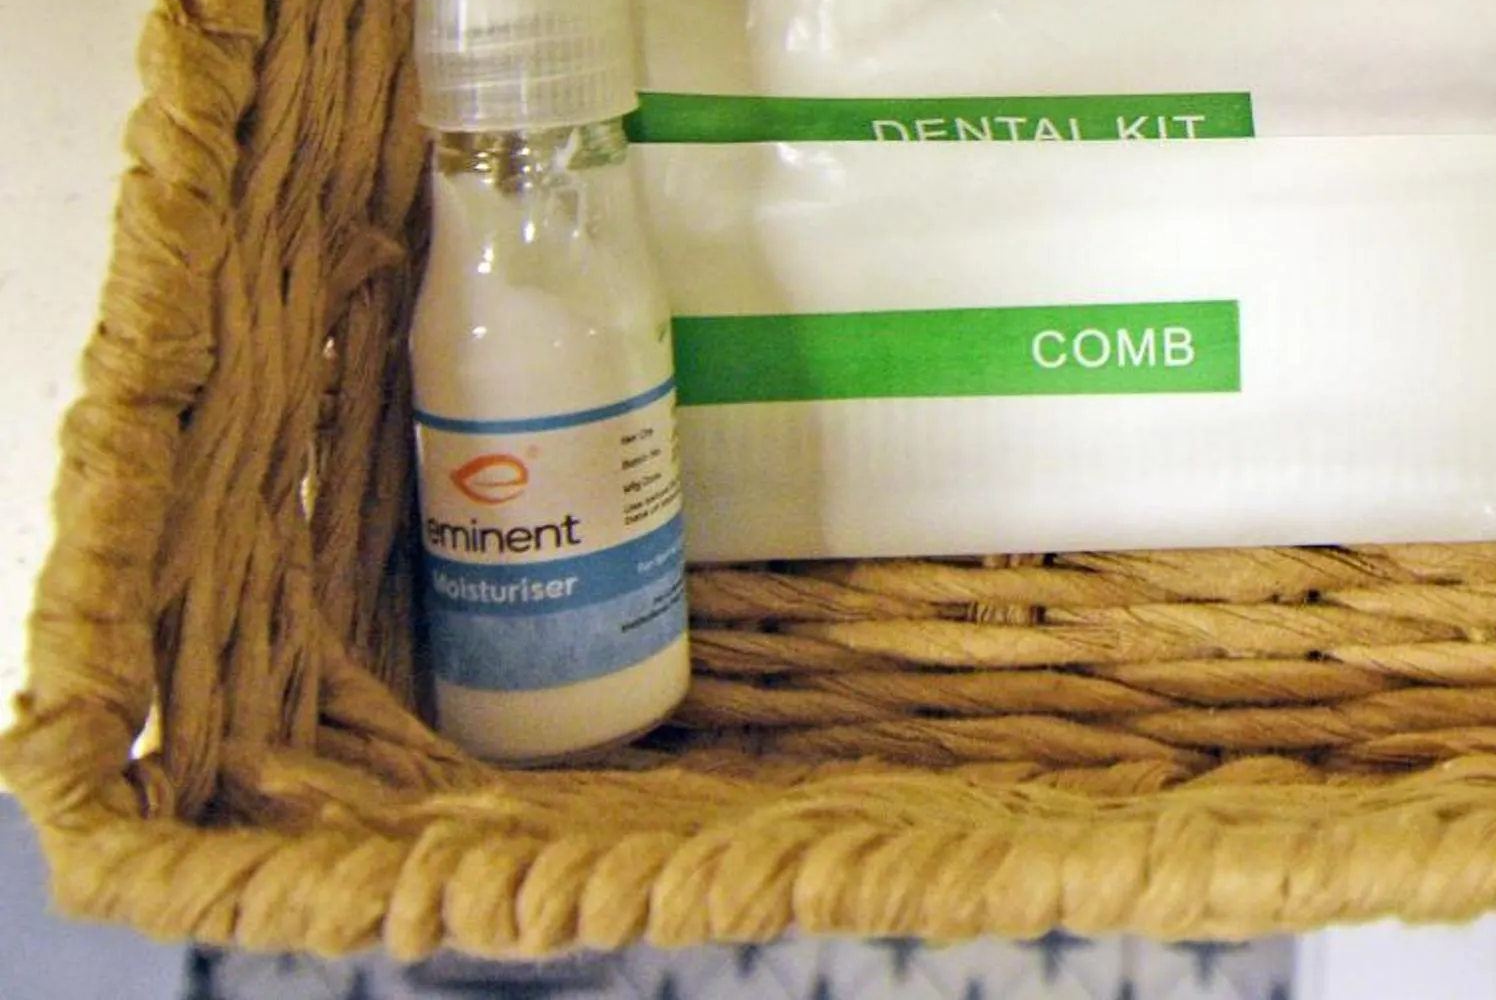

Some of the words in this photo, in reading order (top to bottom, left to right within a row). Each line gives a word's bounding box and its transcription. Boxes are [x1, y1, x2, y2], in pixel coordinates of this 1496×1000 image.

[1115, 114, 1206, 140] KIT
[1032, 327, 1196, 369] COMB
[427, 514, 582, 554] eminent
[432, 569, 580, 603] Moisturiser
